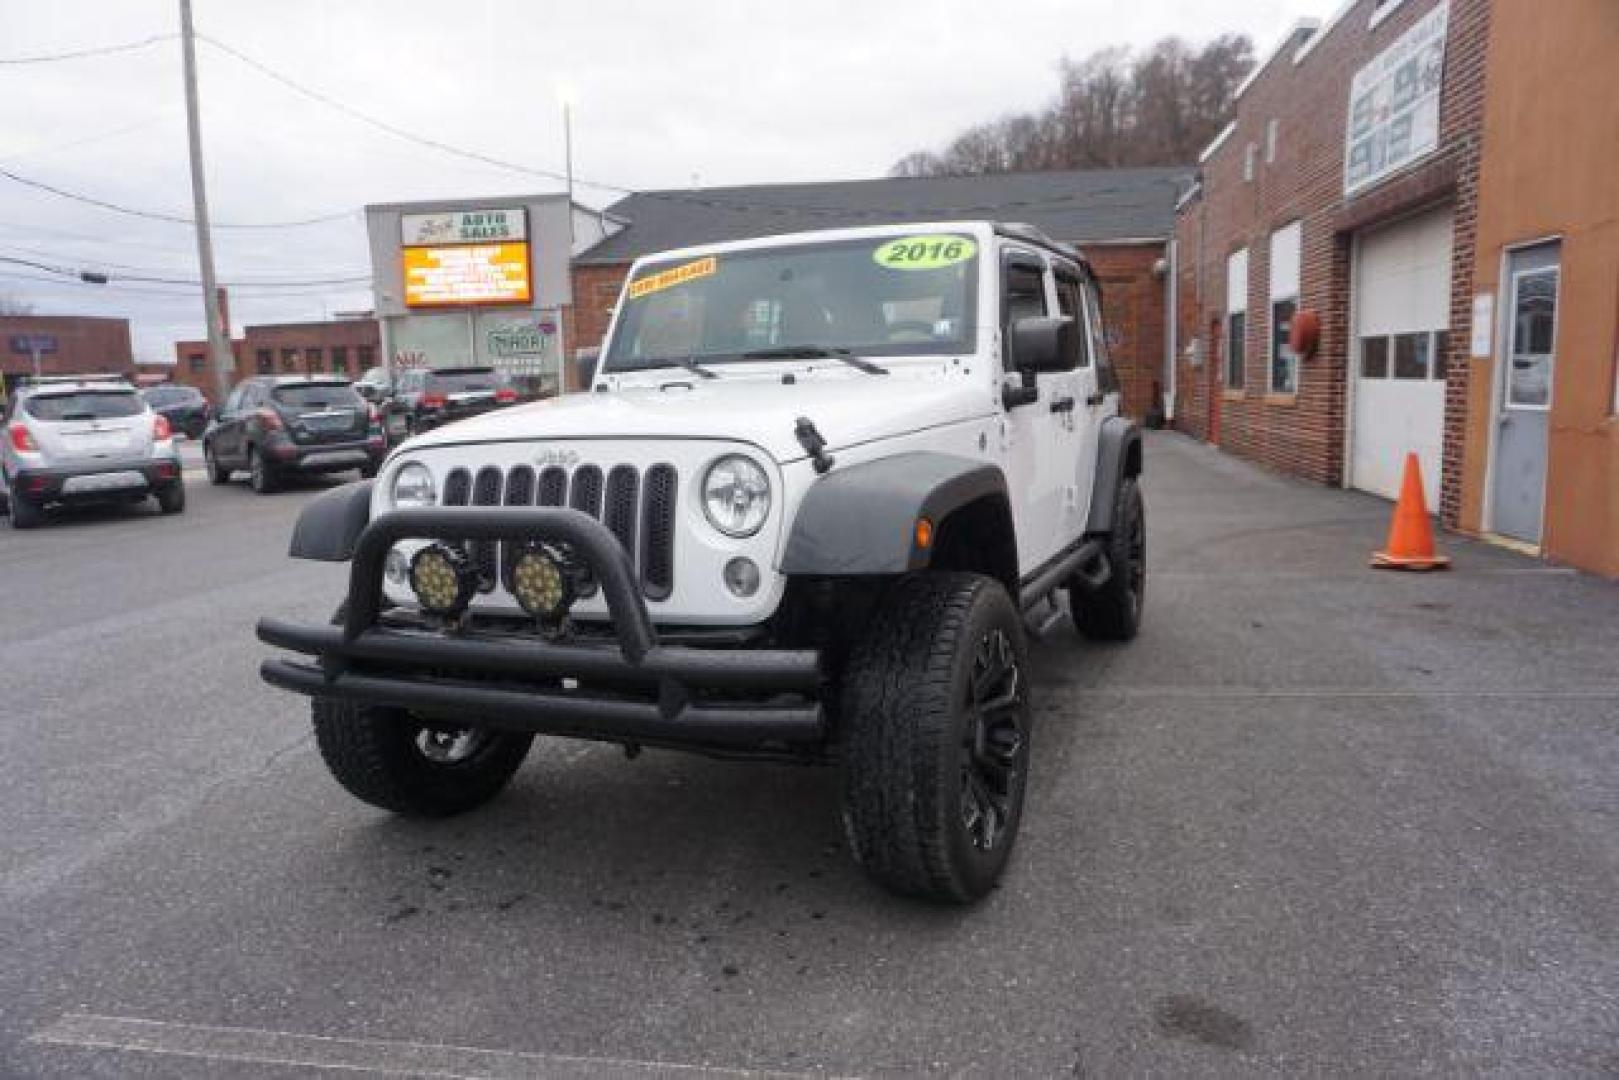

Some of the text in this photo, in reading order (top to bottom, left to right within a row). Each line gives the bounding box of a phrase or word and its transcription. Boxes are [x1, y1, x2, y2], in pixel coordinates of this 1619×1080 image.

[462, 212, 507, 226] AUTO
[462, 226, 509, 239] SALES
[887, 242, 963, 262] 2016
